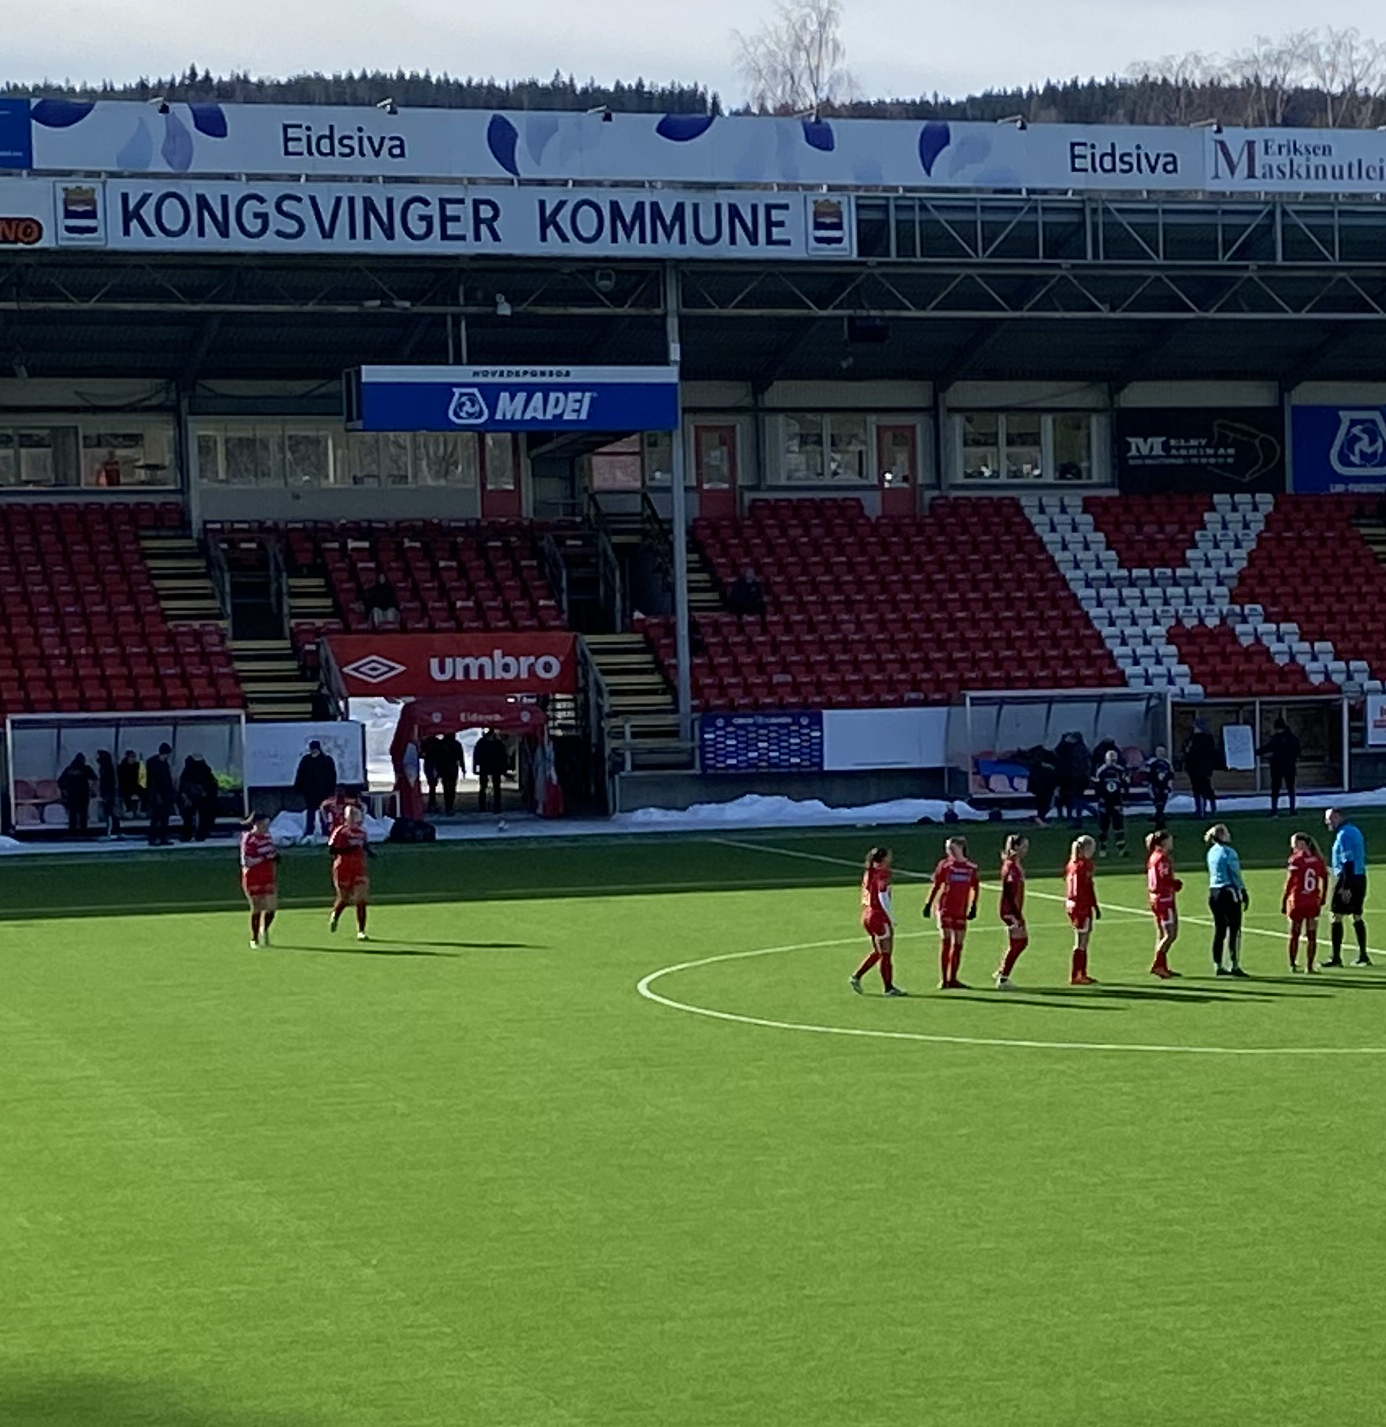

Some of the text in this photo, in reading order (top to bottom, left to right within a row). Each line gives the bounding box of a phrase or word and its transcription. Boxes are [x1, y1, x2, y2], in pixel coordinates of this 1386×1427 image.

[282, 123, 406, 159] Eidsiva
[1263, 138, 1333, 157] Eriksen
[1069, 142, 1179, 174] Eidsiva
[120, 190, 793, 247] KONGSVINGER KOMMUNE
[494, 392, 592, 421] MAPEI
[429, 649, 561, 682] umbro
[1303, 868, 1317, 892] 6
